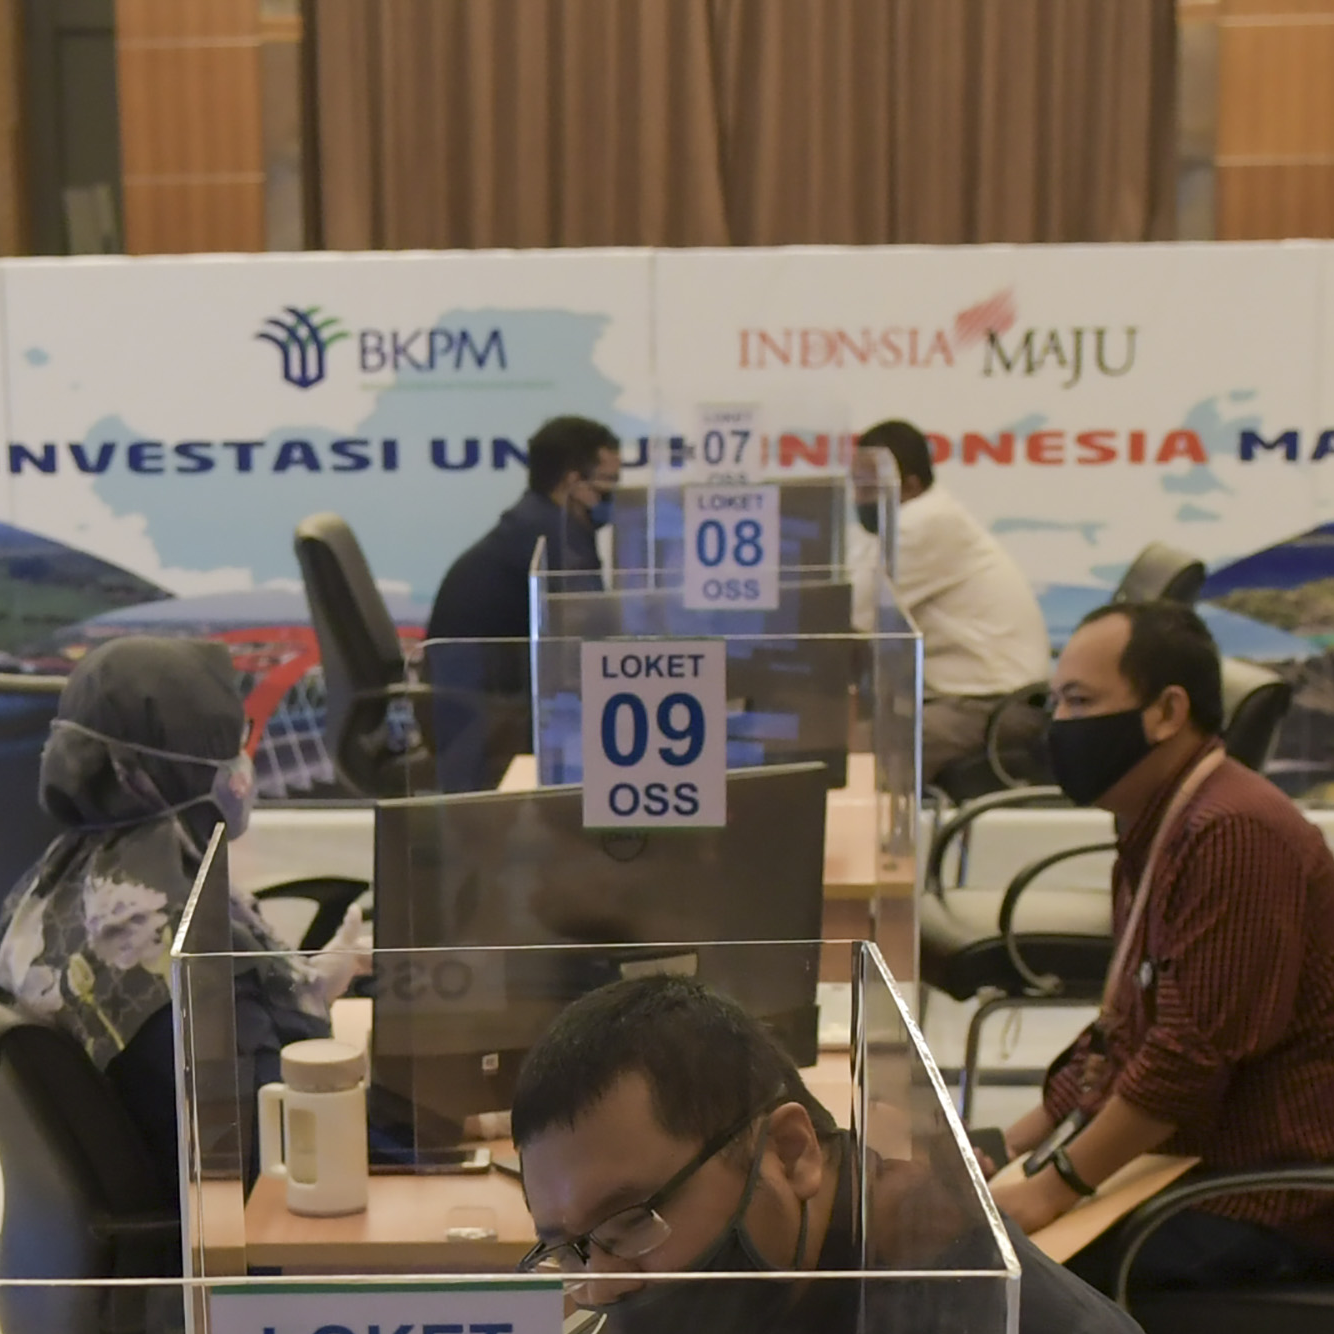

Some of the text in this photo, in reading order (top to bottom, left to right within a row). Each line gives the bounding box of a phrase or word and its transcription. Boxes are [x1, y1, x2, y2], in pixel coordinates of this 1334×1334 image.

[359, 329, 508, 373] BKPM
[980, 326, 1140, 391] MAJU
[703, 430, 751, 465] 07
[698, 494, 764, 511] LOKET
[696, 518, 764, 567] 08
[702, 579, 761, 600] OSS
[602, 655, 705, 678] LOKET
[601, 692, 706, 767] 09
[608, 783, 700, 817] OSS
